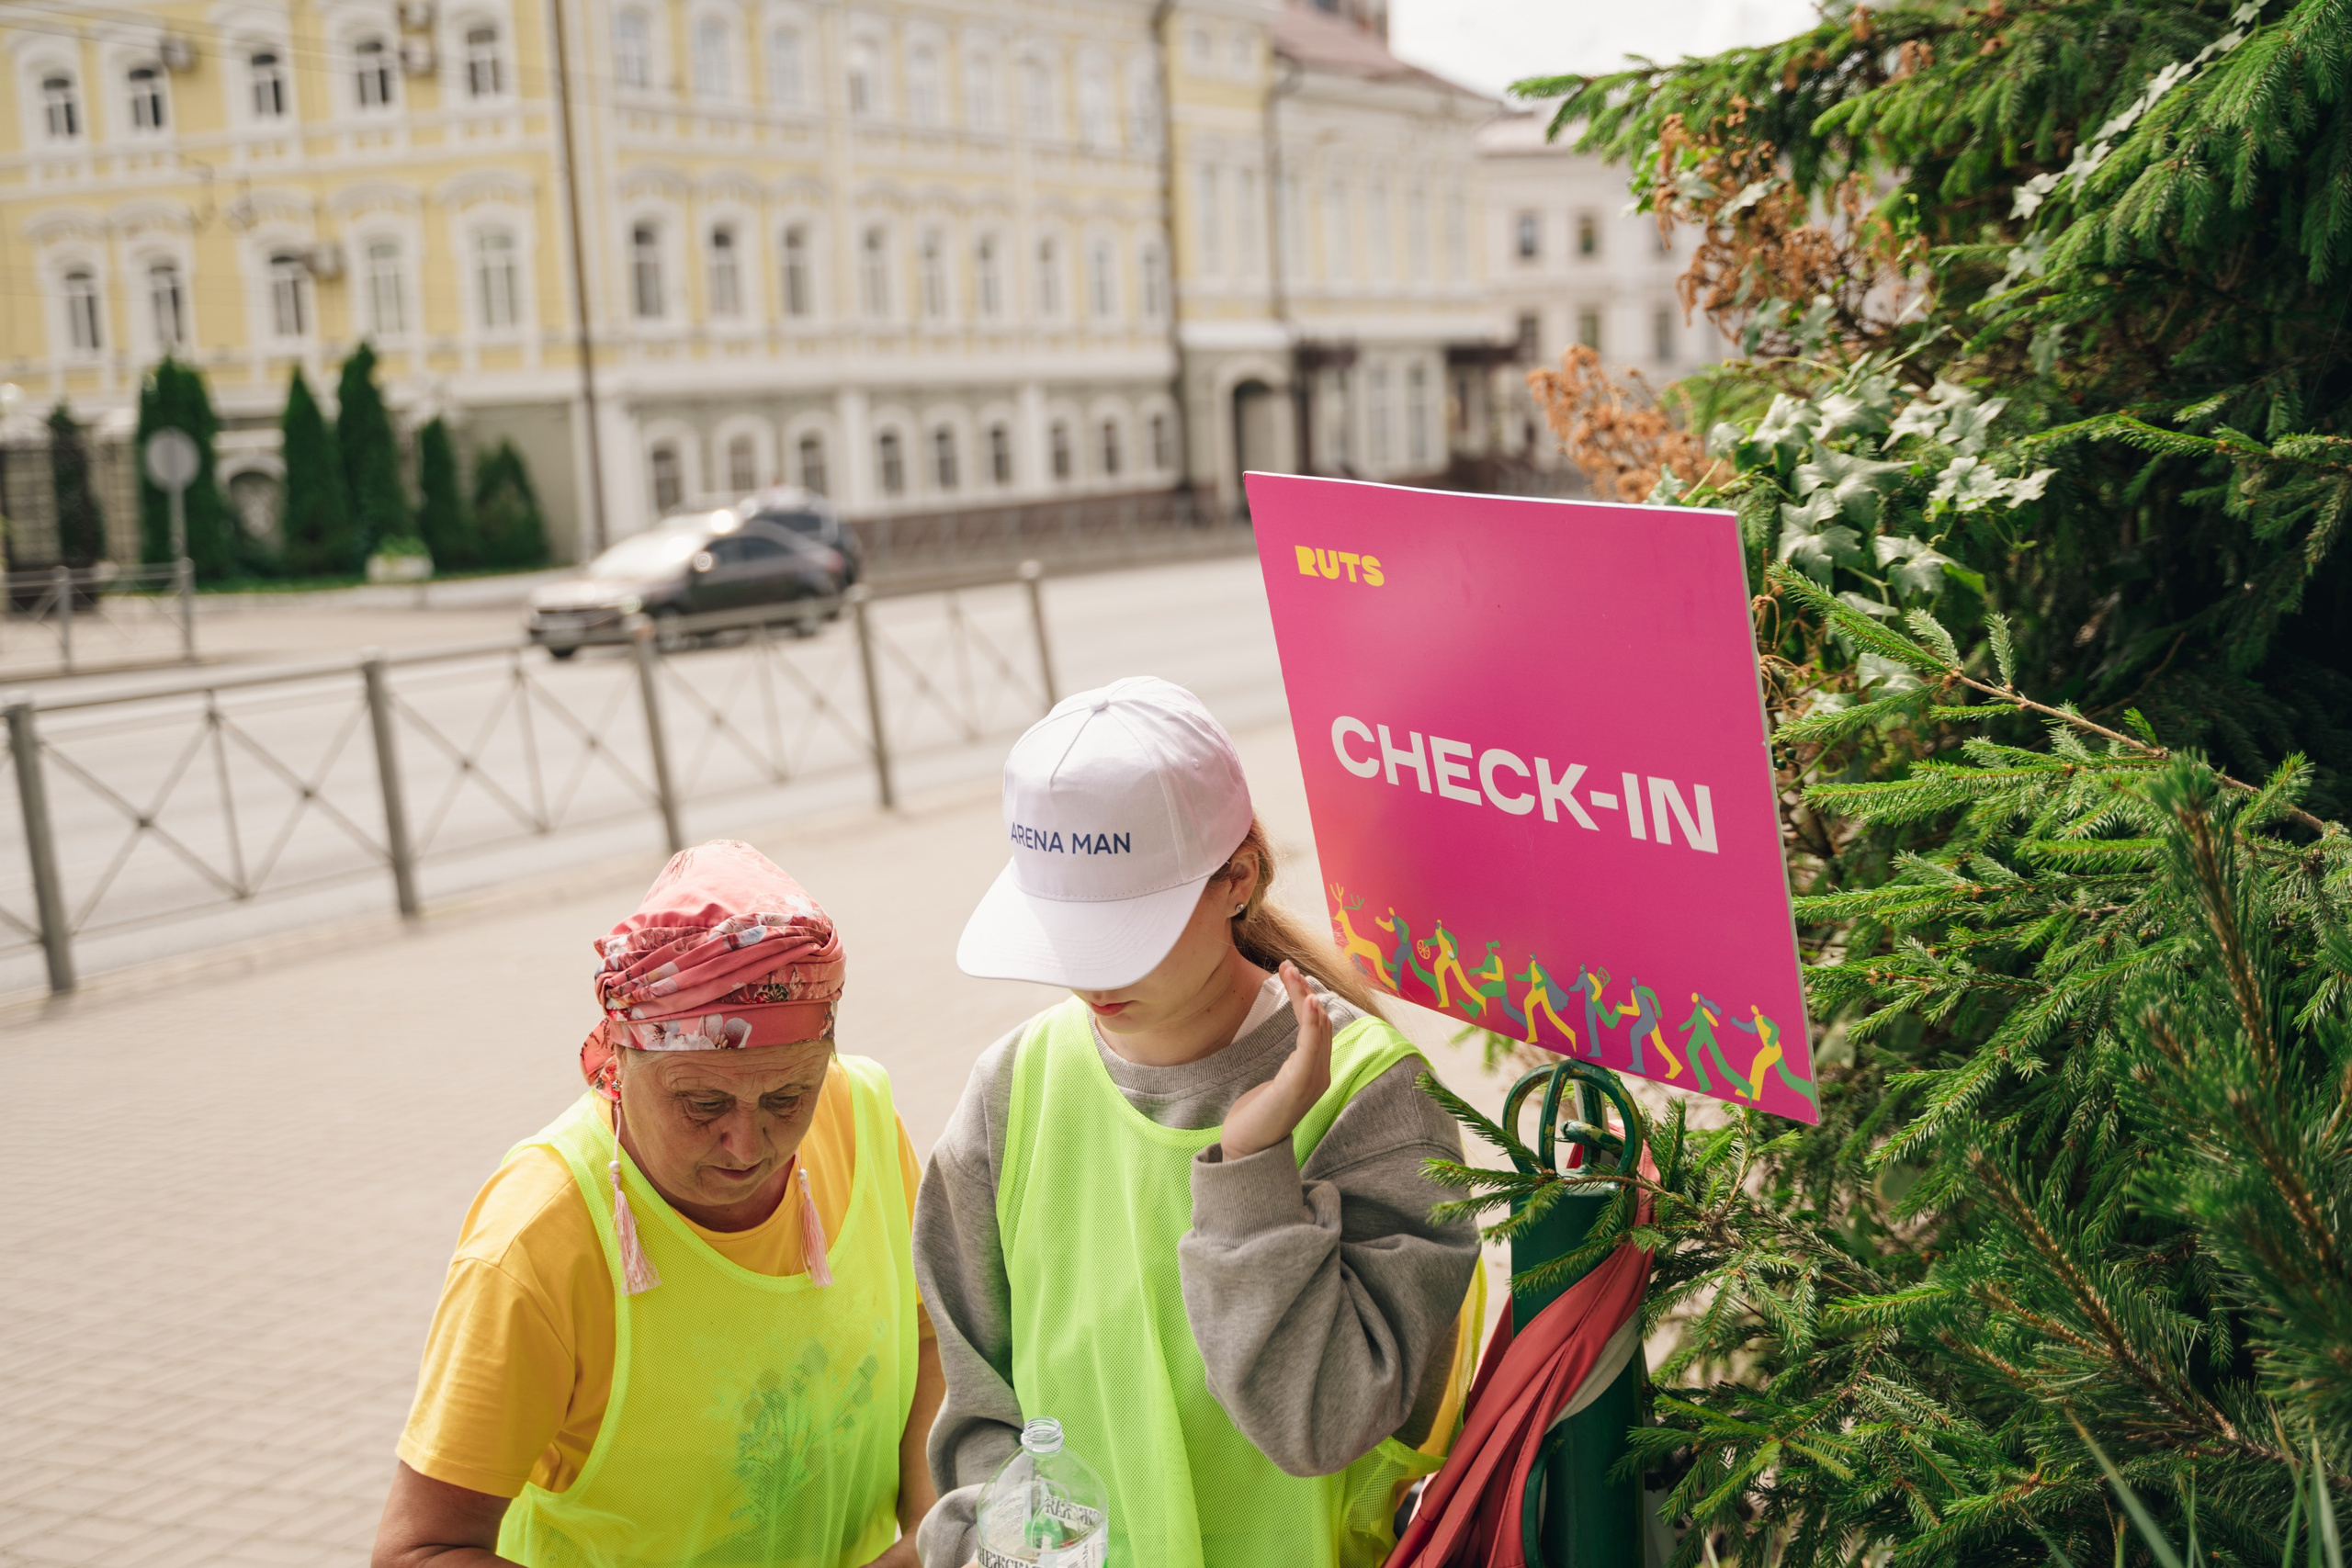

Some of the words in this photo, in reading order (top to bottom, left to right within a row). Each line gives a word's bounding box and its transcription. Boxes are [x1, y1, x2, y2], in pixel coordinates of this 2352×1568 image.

[1295, 545, 1385, 587] RUTS
[1331, 716, 1719, 854] CHECK-IN
[1011, 821, 1064, 853] ARENA
[1072, 832, 1131, 854] MAN
[977, 1545, 1042, 1568] НЕЖС
